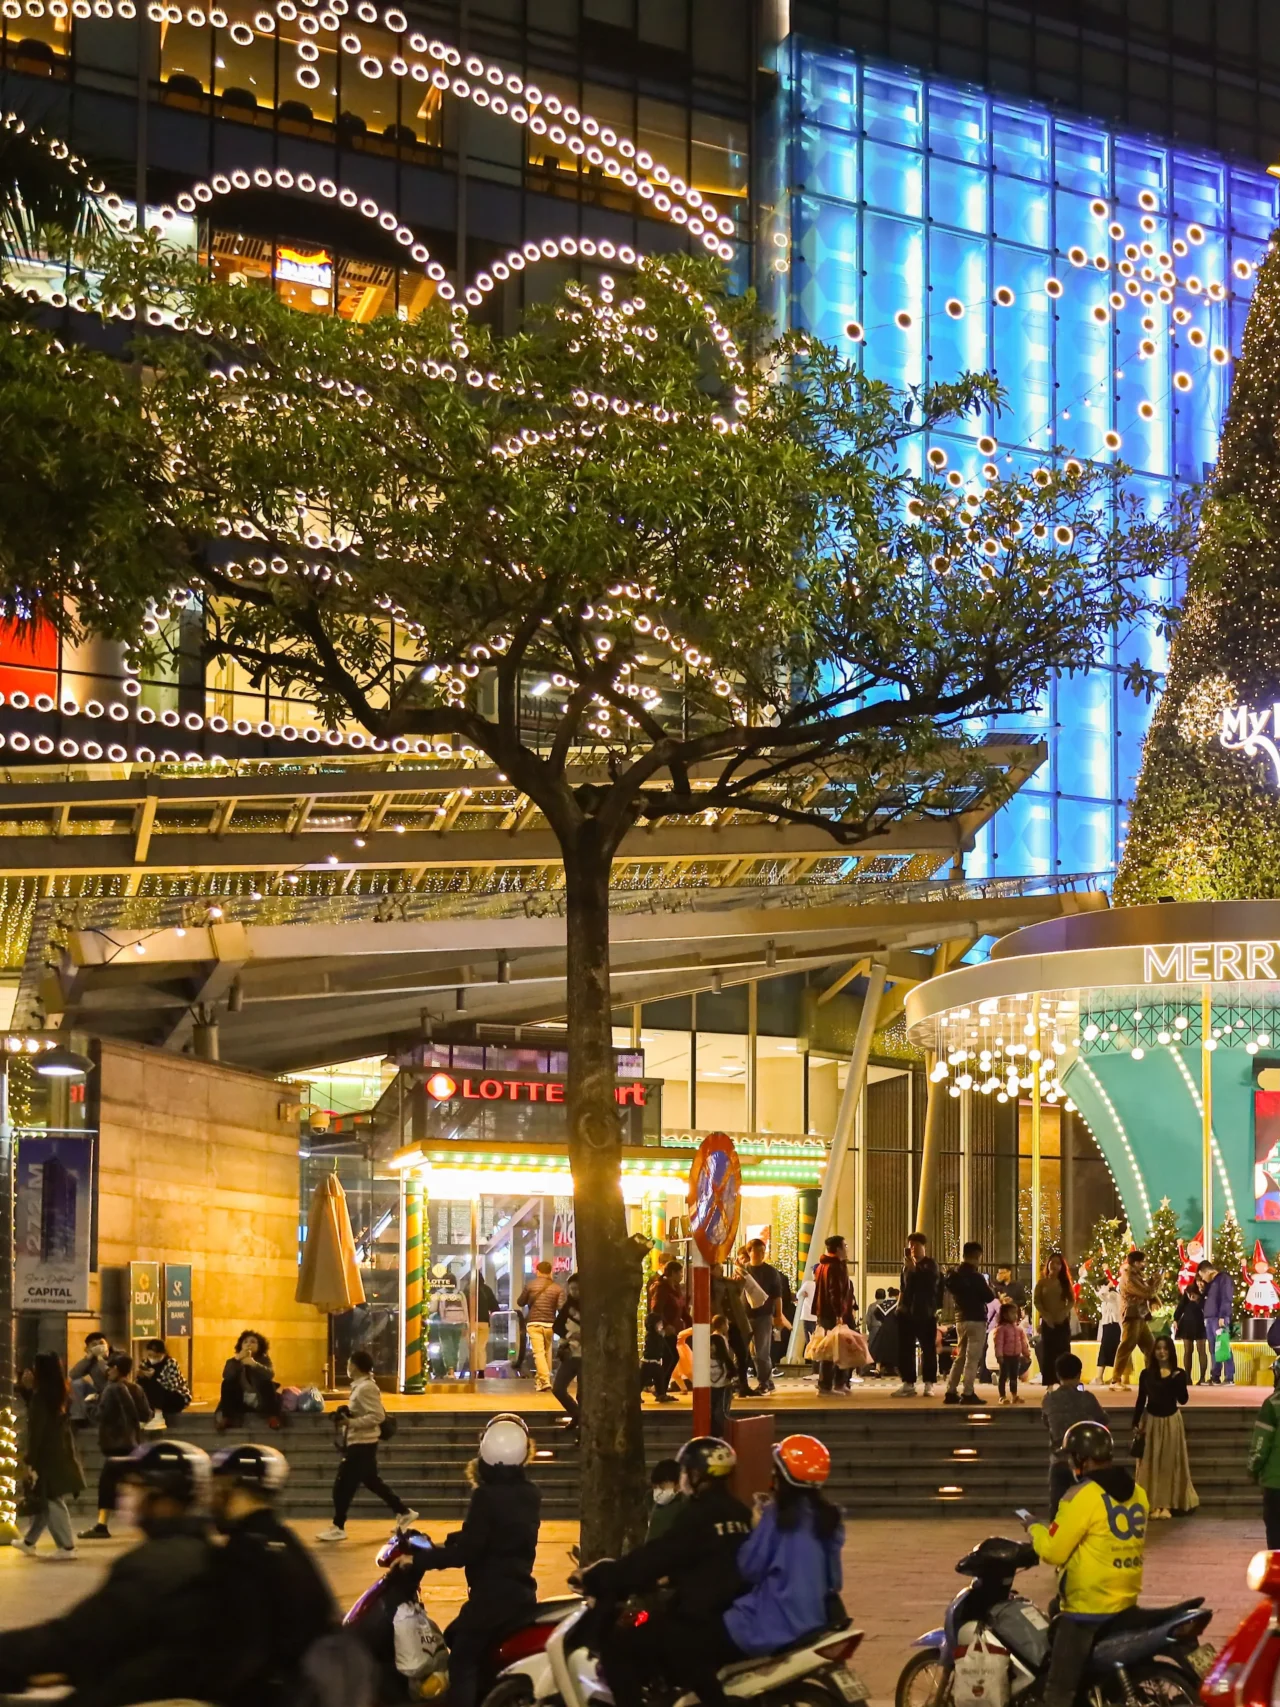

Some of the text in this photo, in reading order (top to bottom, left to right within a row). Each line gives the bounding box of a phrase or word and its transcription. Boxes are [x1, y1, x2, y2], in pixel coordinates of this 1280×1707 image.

[462, 1079, 564, 1102] LOTTE
[27, 1287, 72, 1297] CAPITAL
[135, 1292, 155, 1305] BIDV
[170, 1311, 185, 1319] BANK
[1101, 1493, 1146, 1541] be
